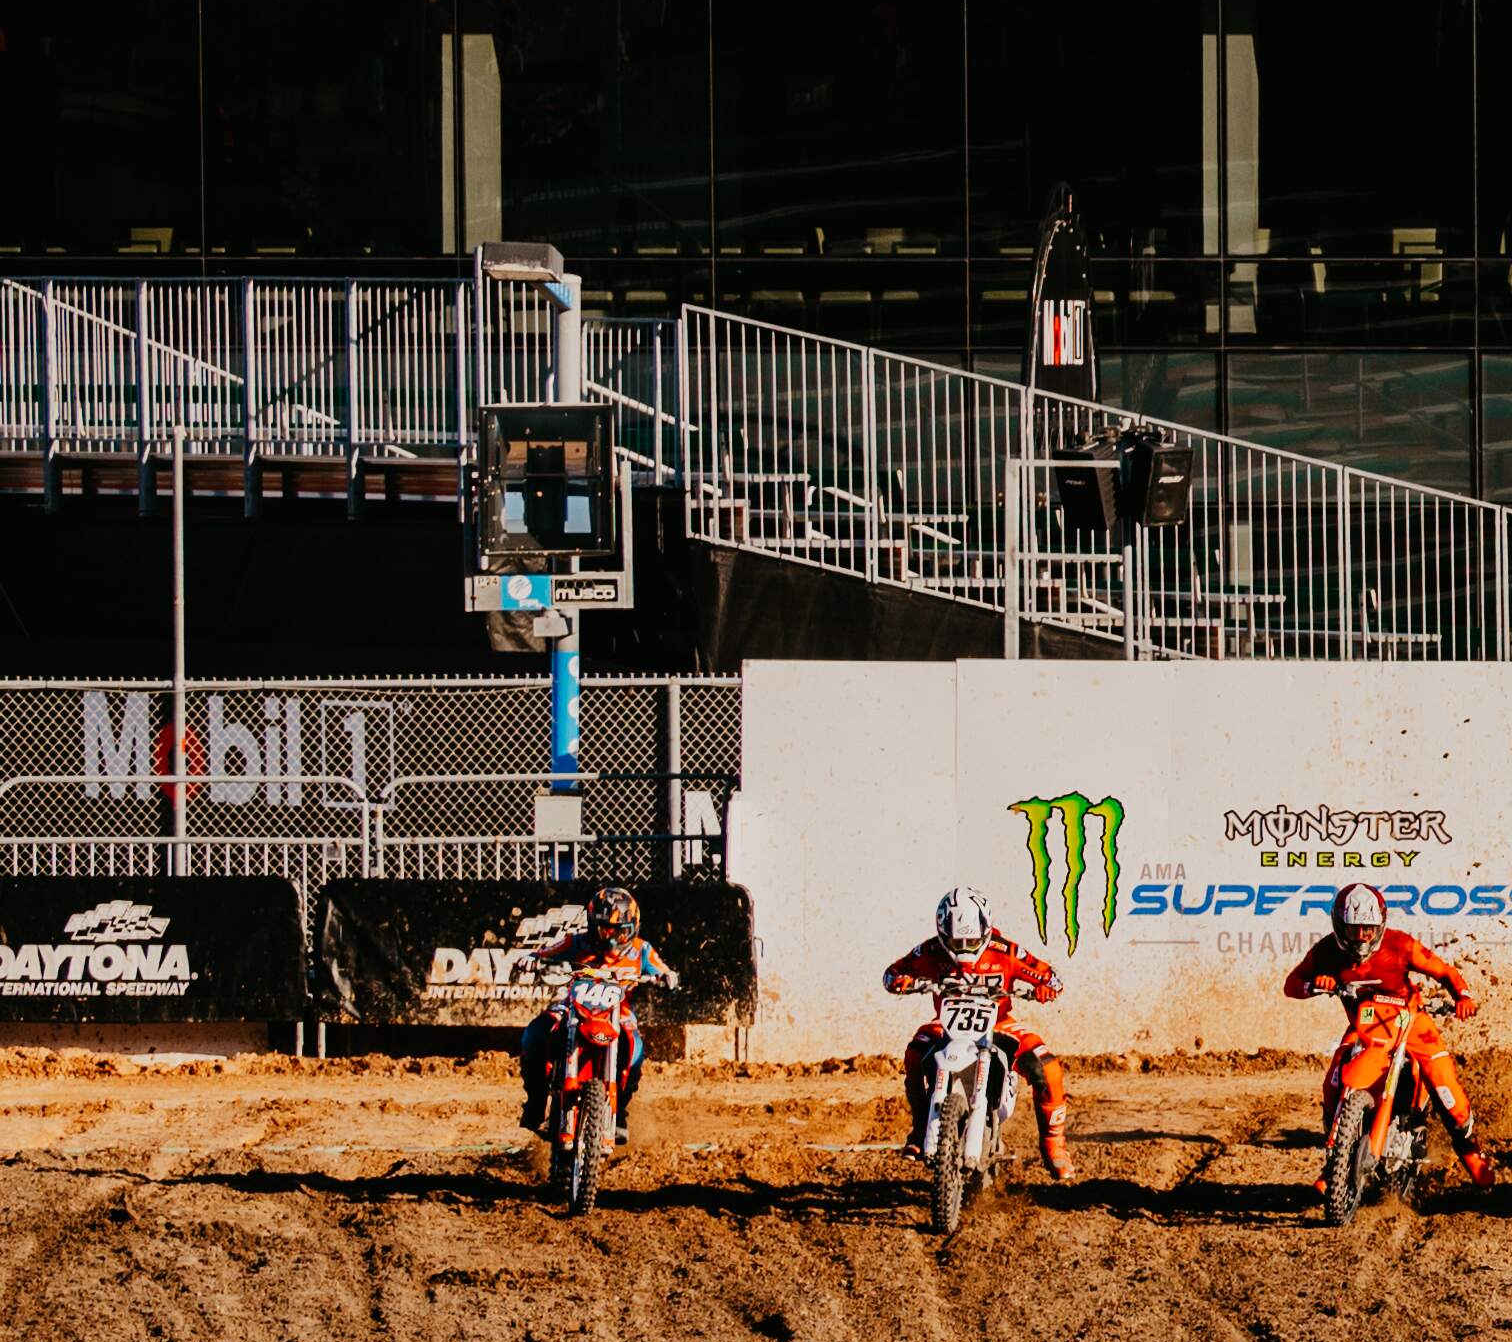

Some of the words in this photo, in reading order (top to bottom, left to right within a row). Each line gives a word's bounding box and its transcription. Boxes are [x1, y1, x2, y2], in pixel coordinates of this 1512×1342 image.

[83, 691, 301, 806] Mobil
[1224, 804, 1452, 847] MONSTER
[1260, 851, 1421, 868] ENERGY
[1140, 863, 1187, 880] AMA
[0, 981, 100, 996] TERNATIONAL
[106, 981, 190, 996] SPEEDWAY
[427, 985, 551, 1000] INTERNATIONAL
[575, 984, 622, 1006] 146
[946, 1007, 992, 1033] 735
